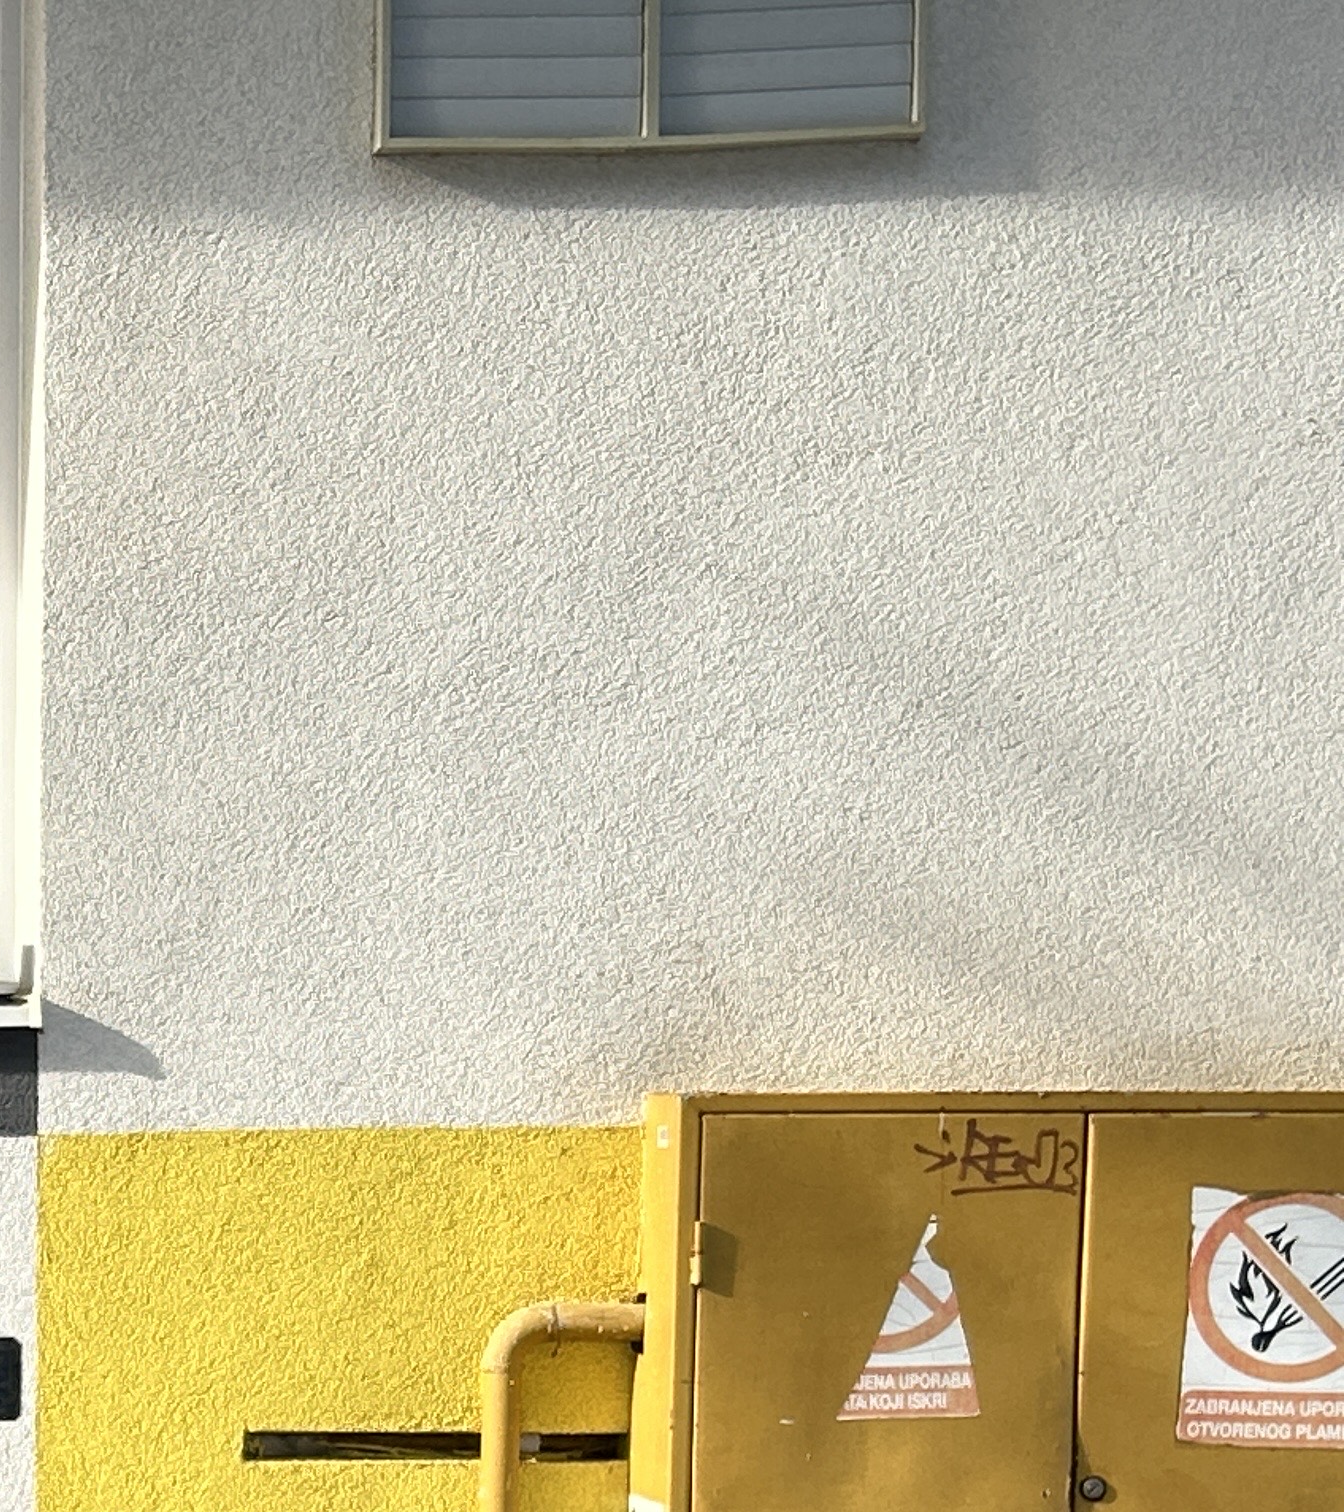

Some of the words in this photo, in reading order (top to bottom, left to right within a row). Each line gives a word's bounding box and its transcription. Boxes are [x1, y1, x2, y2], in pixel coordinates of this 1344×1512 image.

[854, 1373, 896, 1391] JENA
[898, 1371, 972, 1389] UPORABA
[869, 1392, 904, 1410] KOJI
[907, 1391, 948, 1409] ISKRI
[1184, 1398, 1296, 1416] ZABRANJENA
[1186, 1421, 1291, 1440] OTVORENOG
